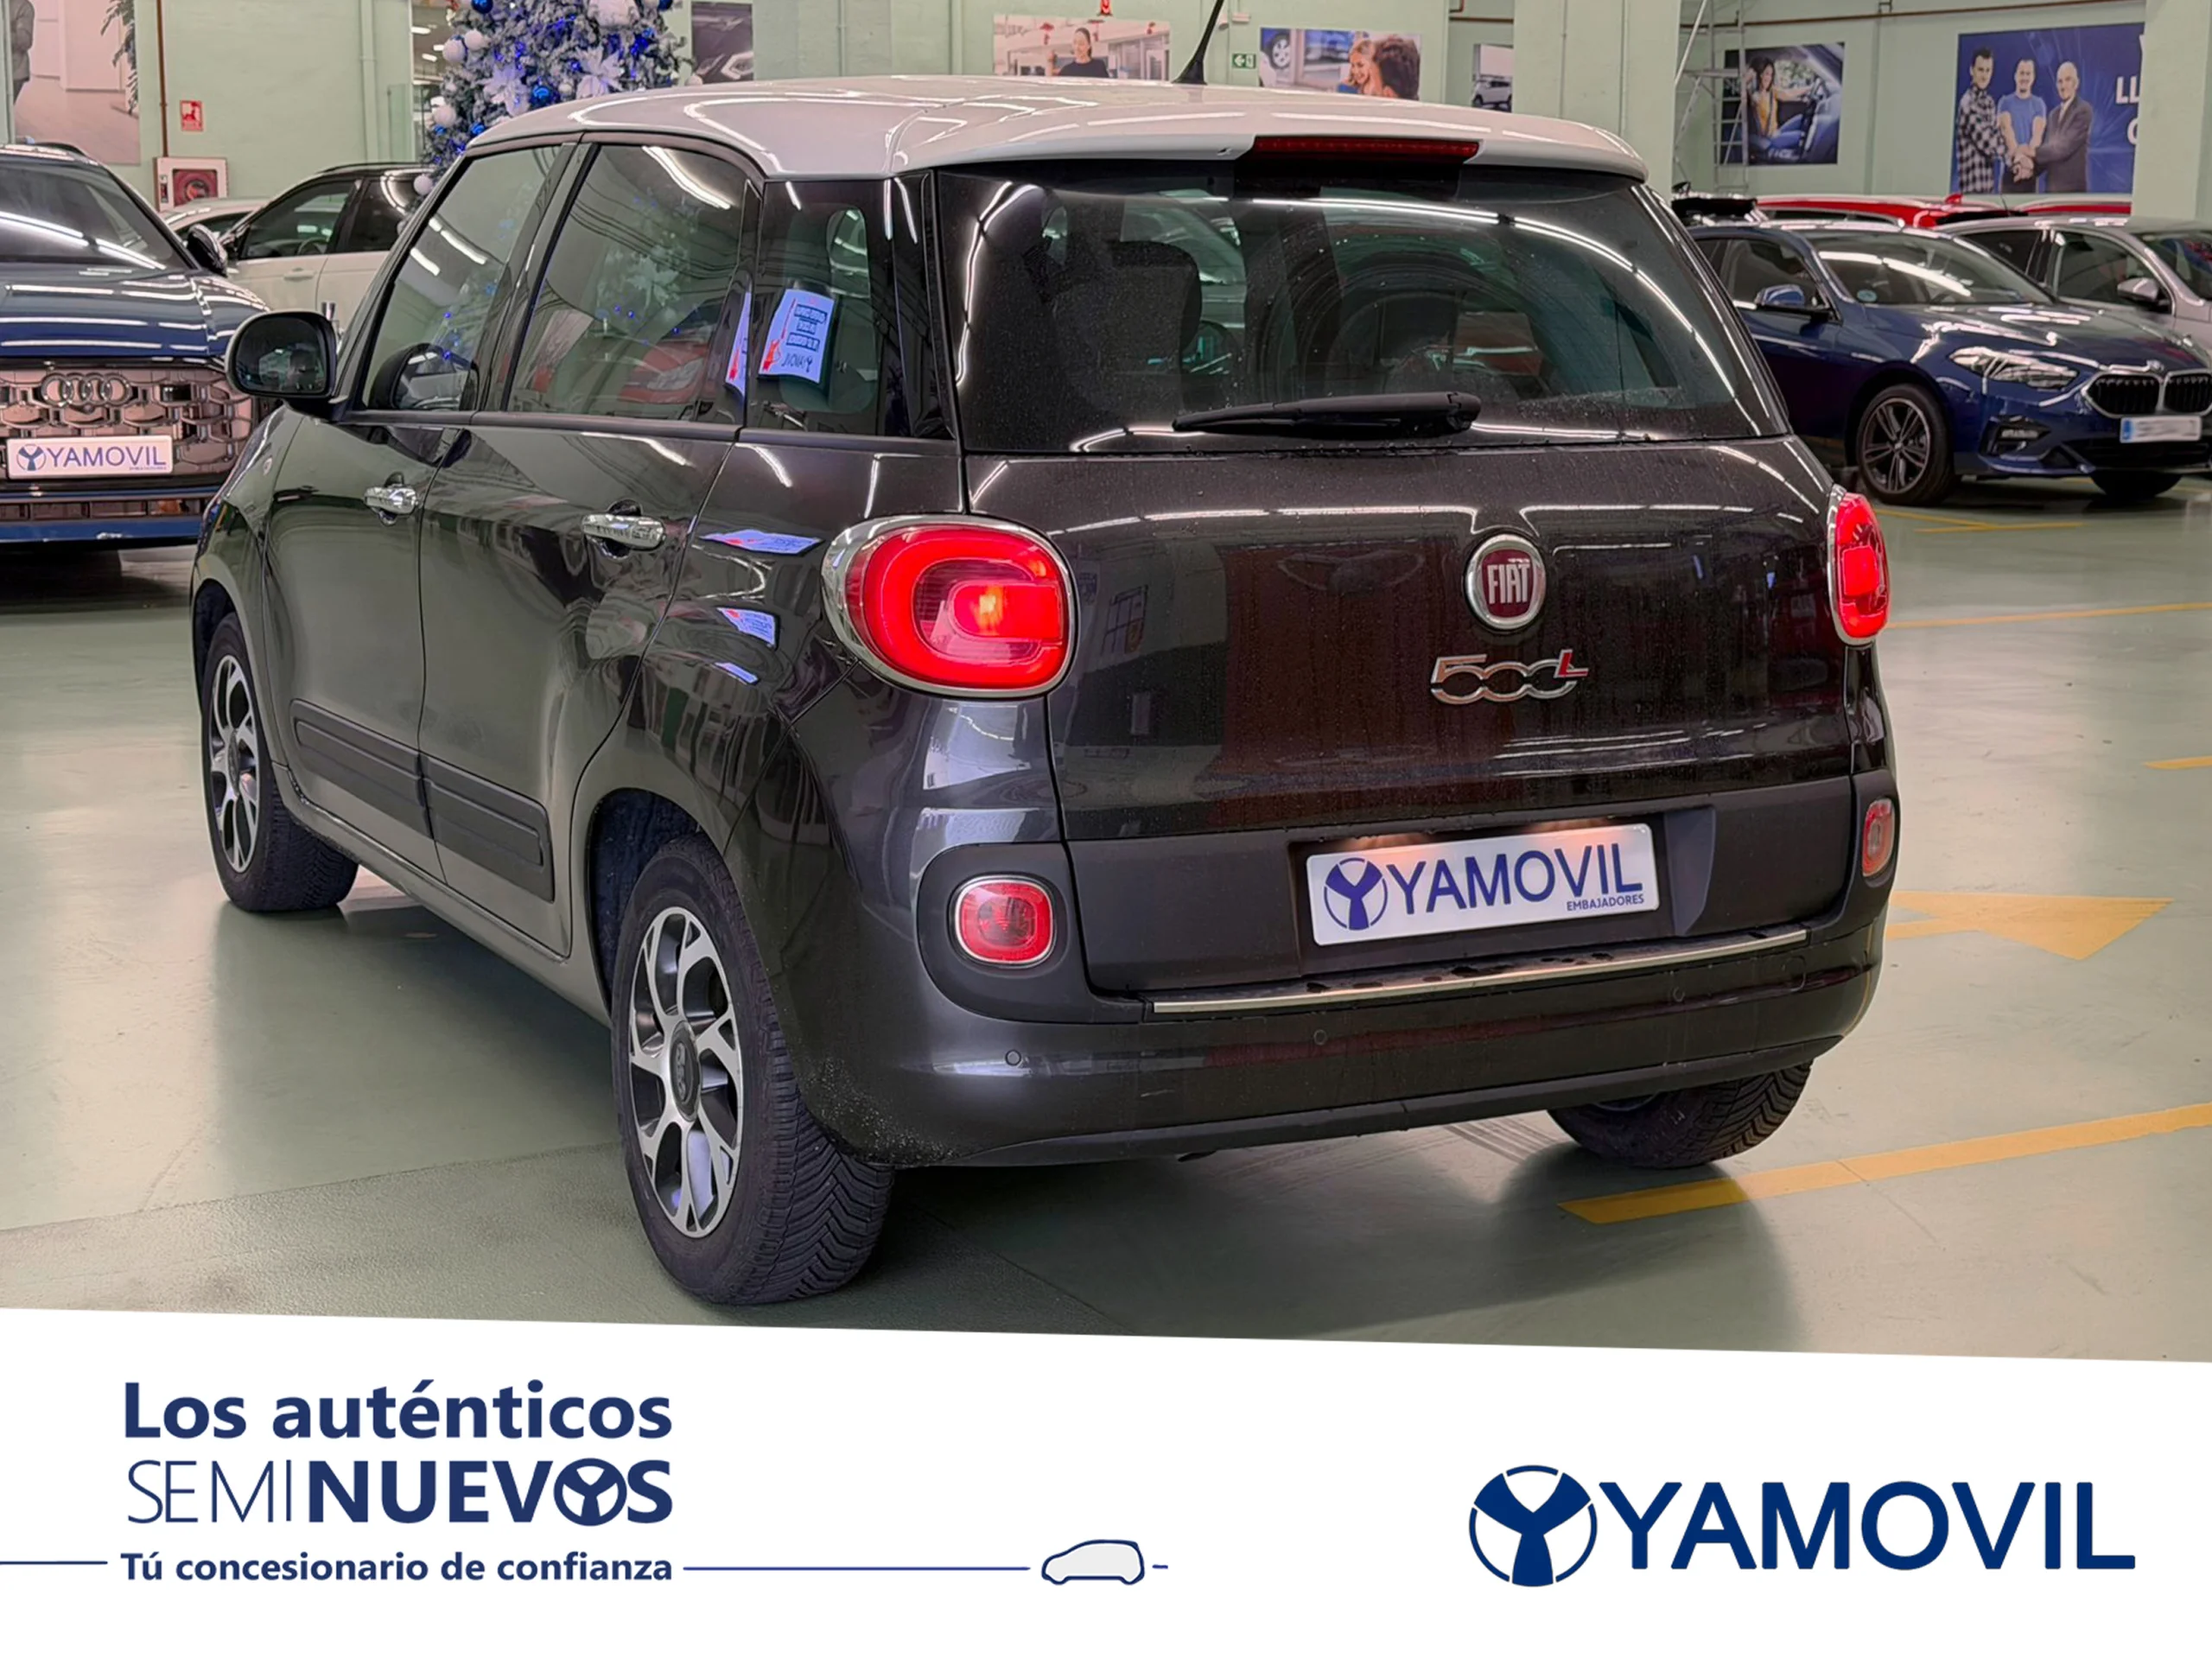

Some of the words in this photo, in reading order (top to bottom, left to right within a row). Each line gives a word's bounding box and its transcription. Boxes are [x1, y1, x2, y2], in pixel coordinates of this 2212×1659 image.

[47, 446, 167, 467] YAMOVIL
[1487, 557, 1530, 605] FIAT
[1430, 649, 1589, 705] 500L
[1386, 842, 1643, 915] YAMOVIL
[1566, 893, 1644, 912] EMBAJADORES
